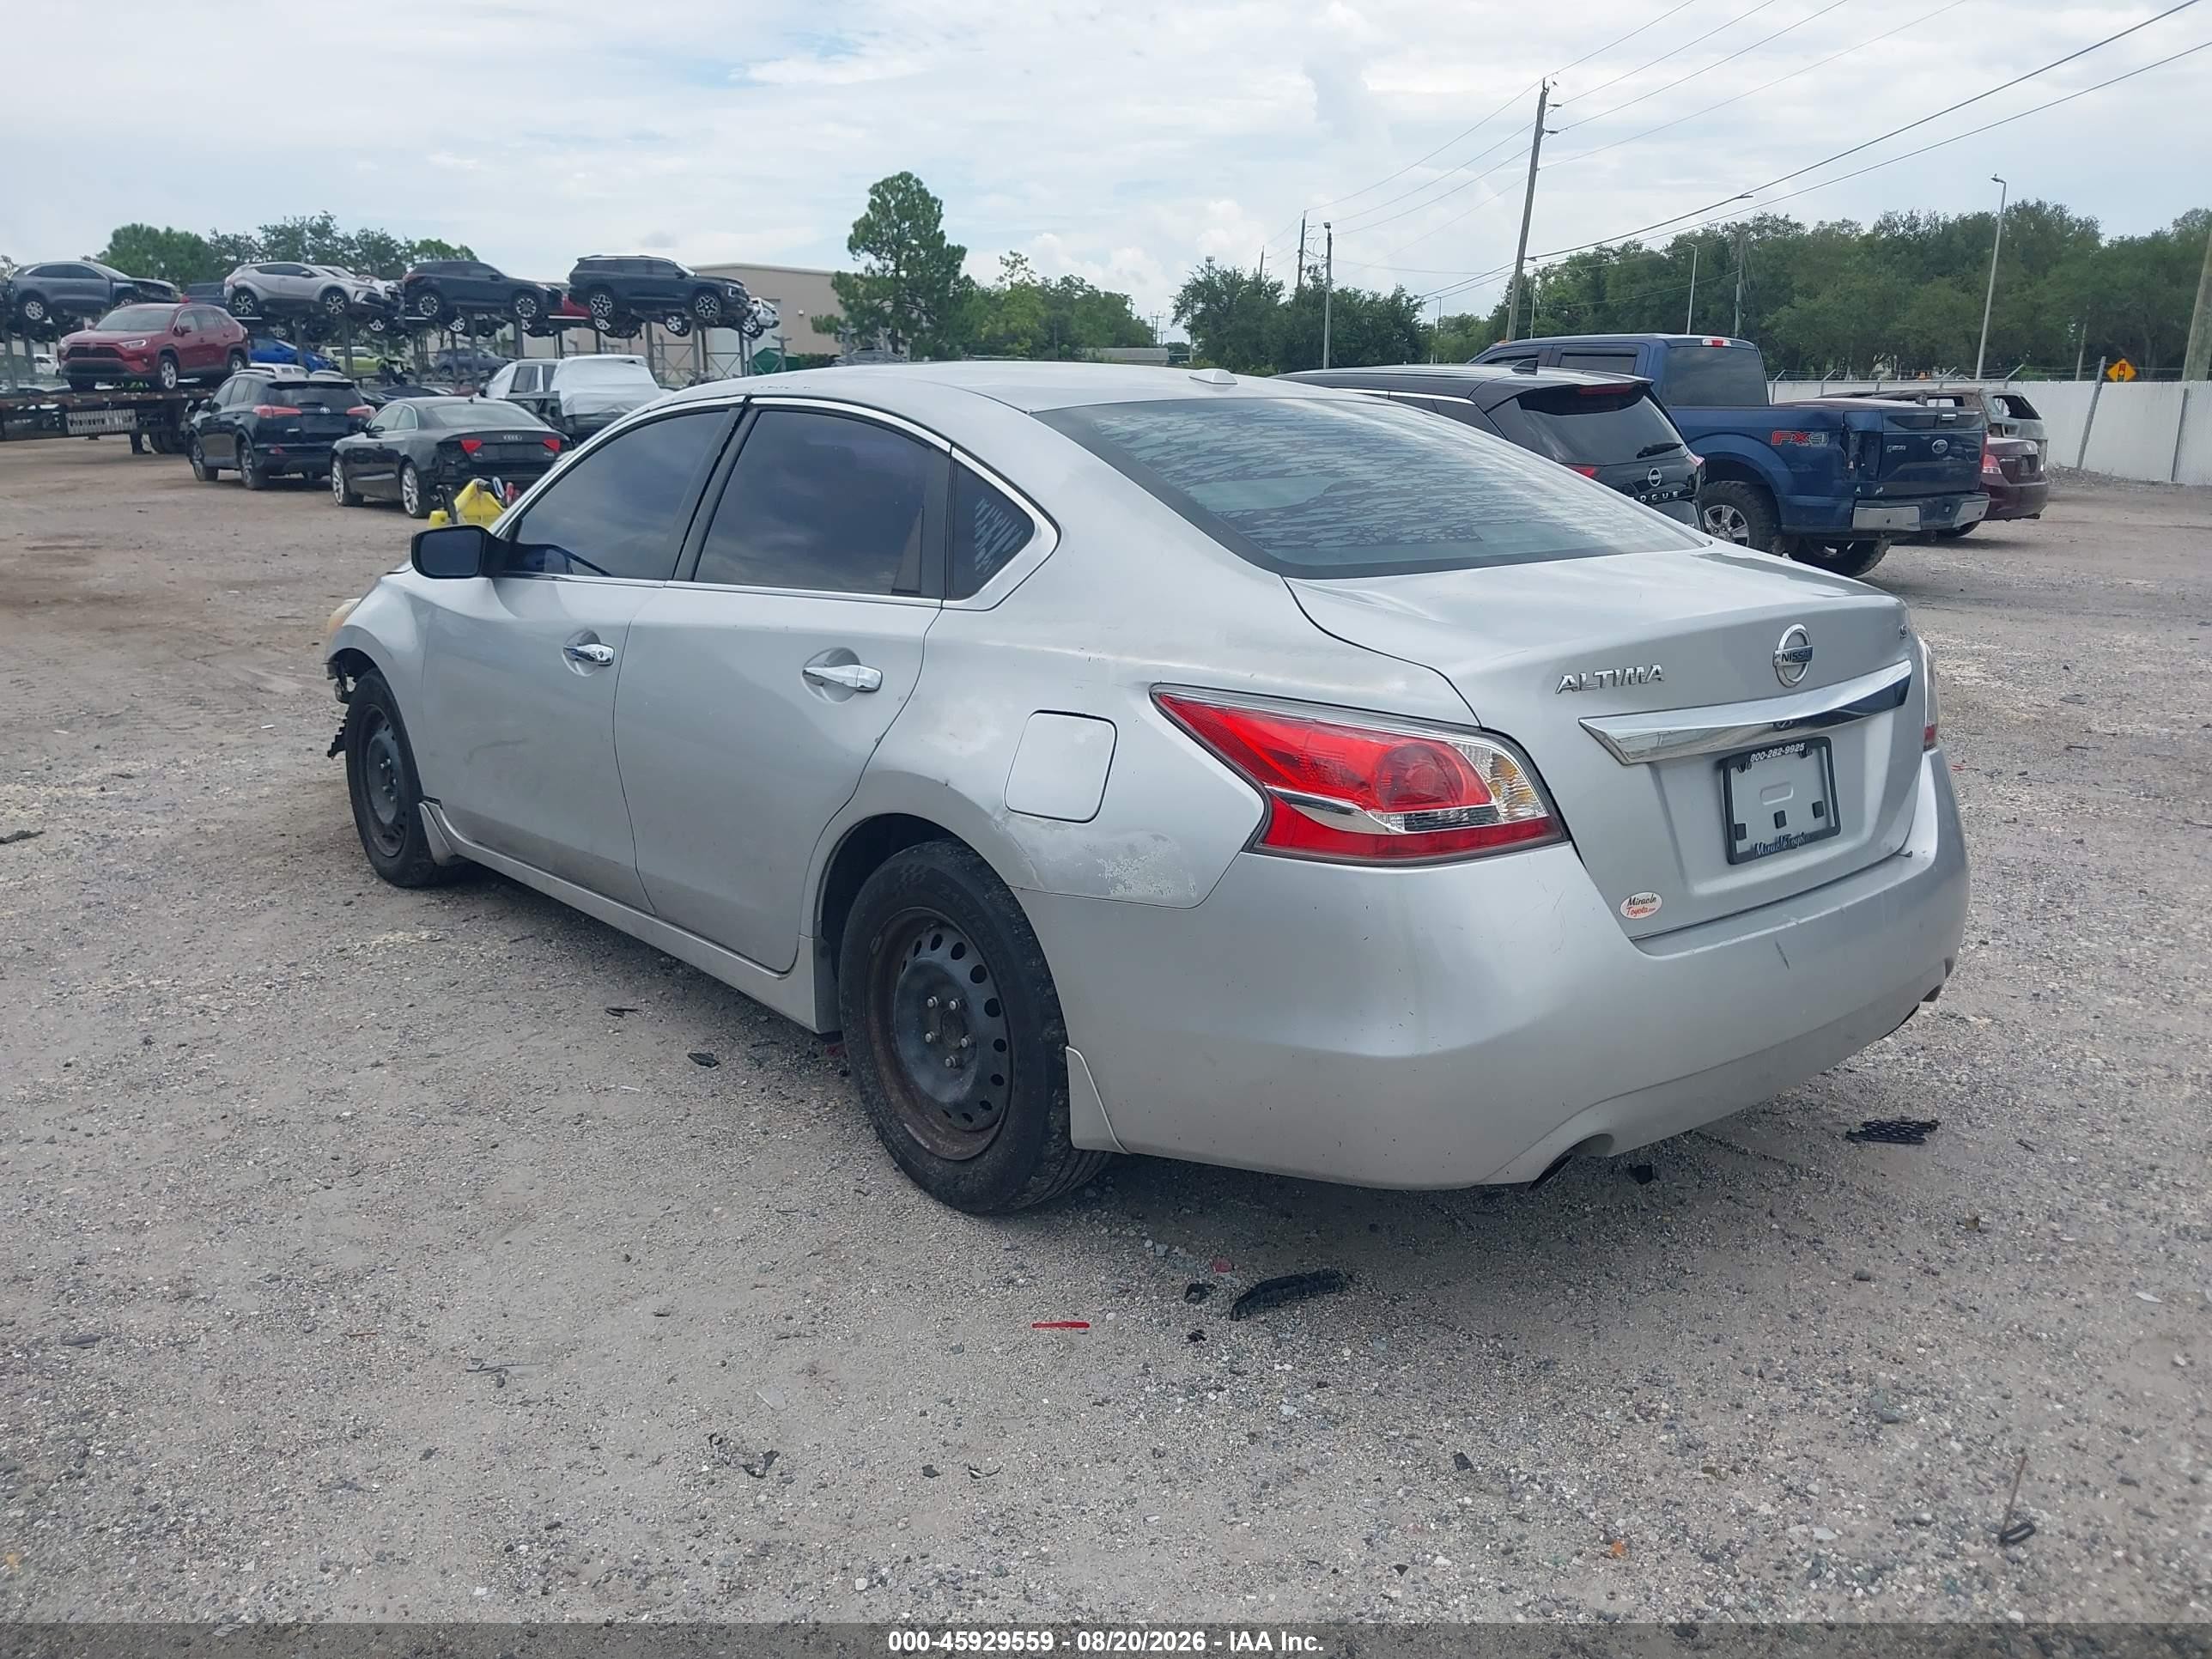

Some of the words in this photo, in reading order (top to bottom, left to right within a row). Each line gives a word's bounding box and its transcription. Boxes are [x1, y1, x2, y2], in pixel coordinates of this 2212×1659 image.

[1771, 430, 1829, 446] FX4
[1630, 489, 1679, 502] OGUE
[1555, 664, 1664, 694] ALTIMA
[1749, 742, 1806, 763] 800-282-9925
[1627, 893, 1657, 907] Miracle
